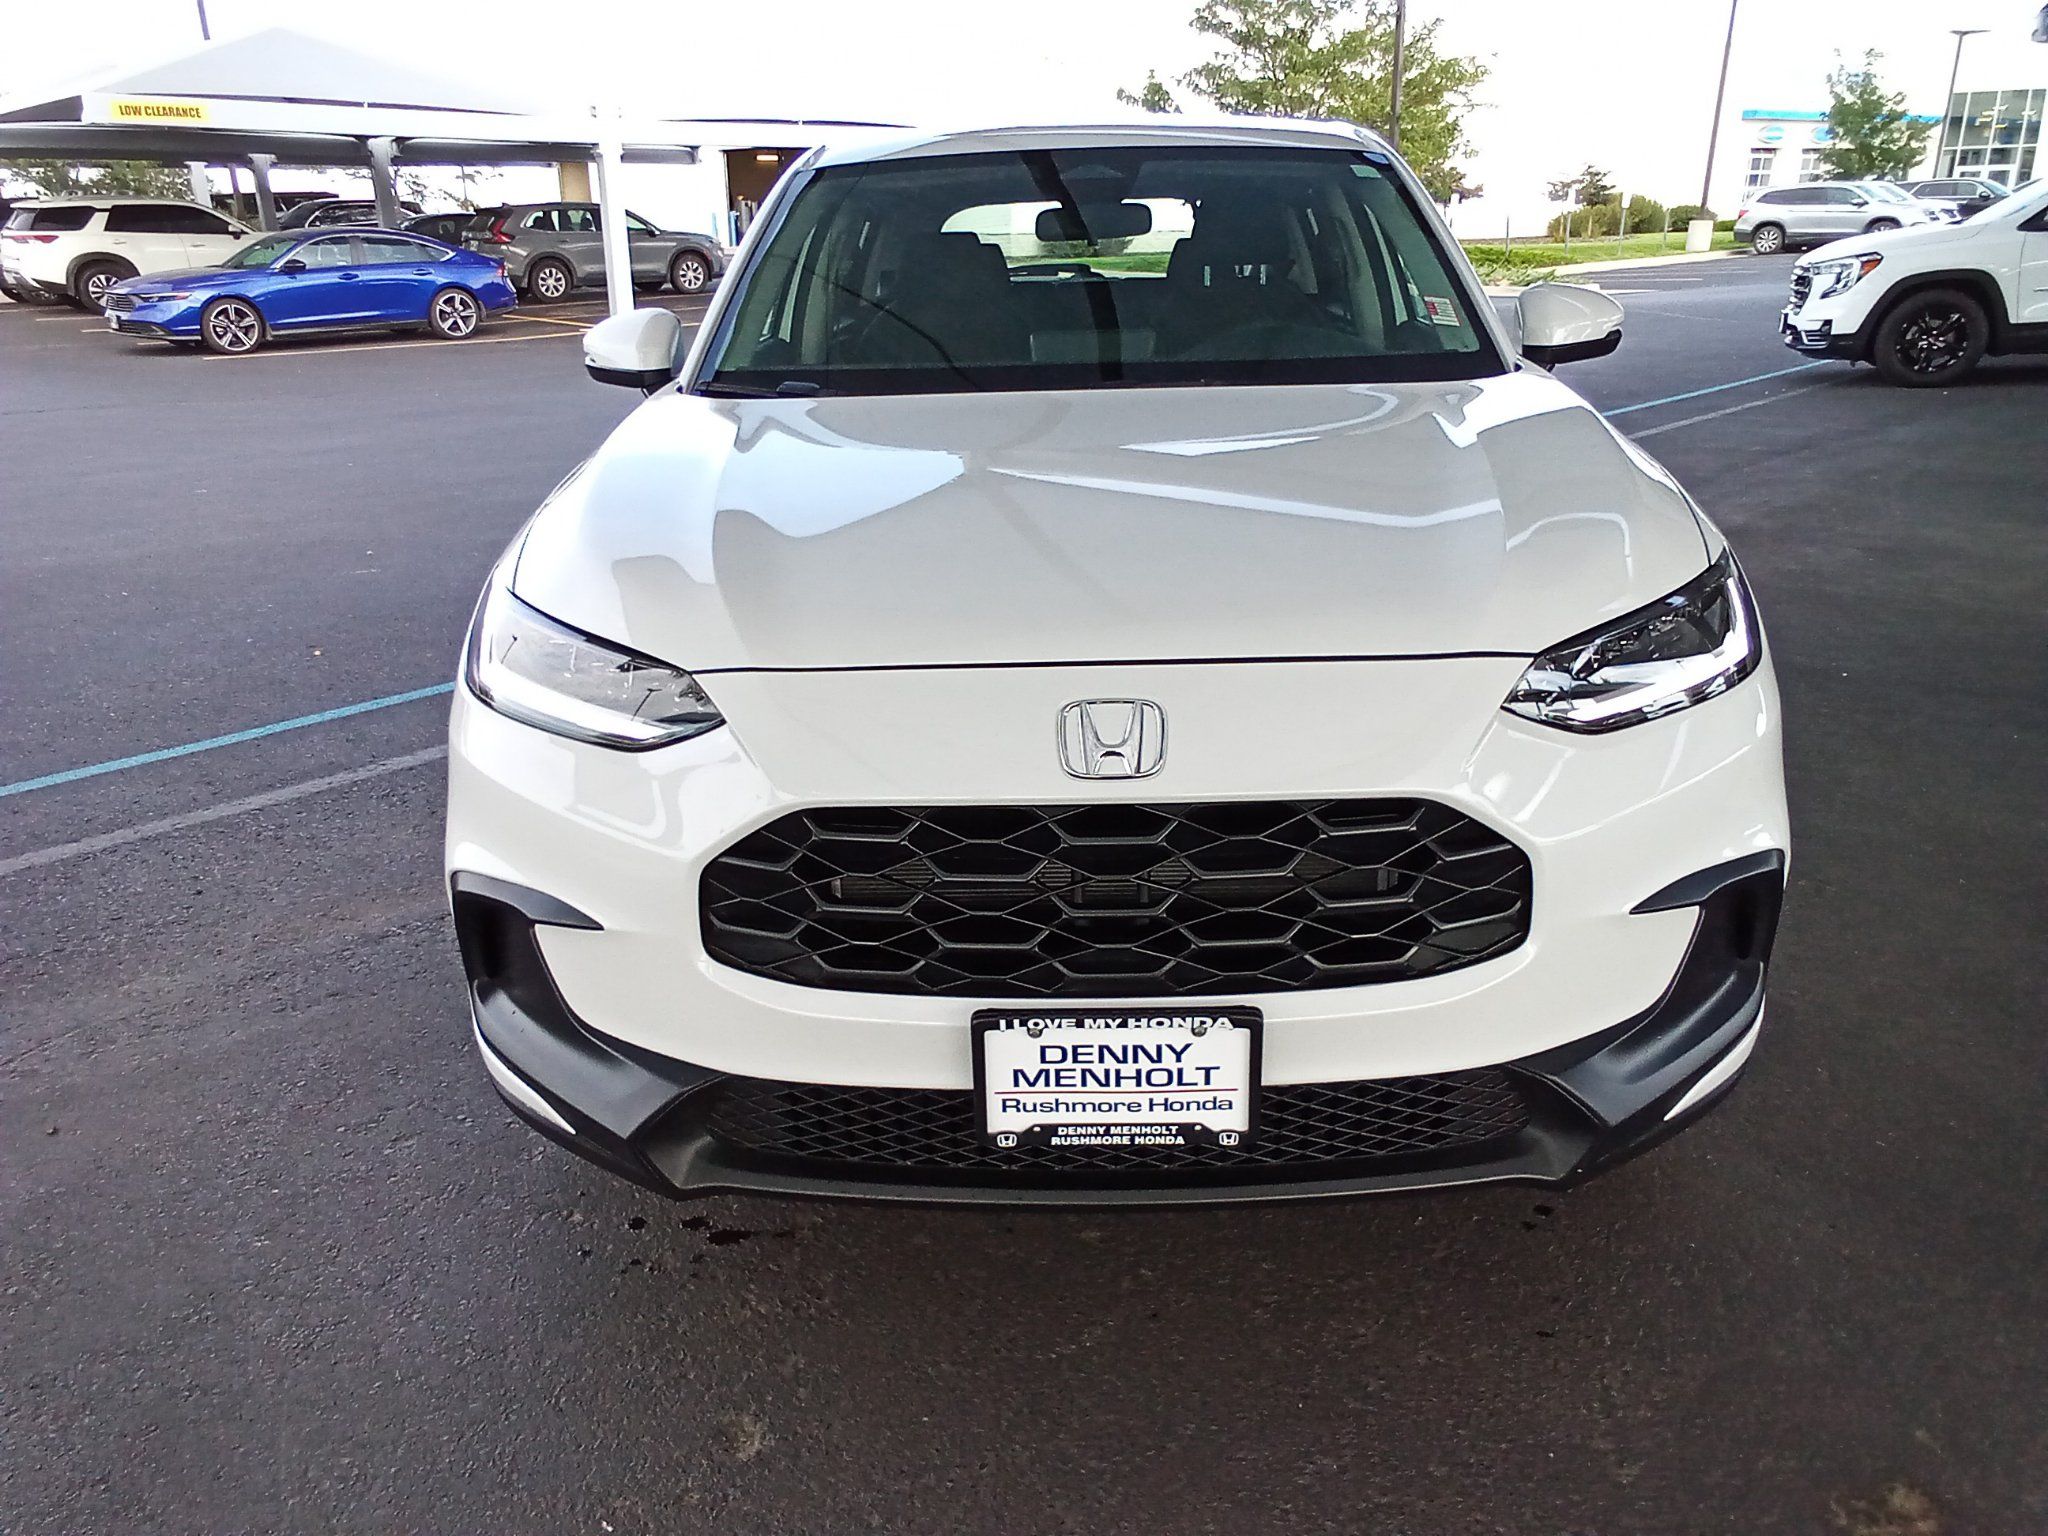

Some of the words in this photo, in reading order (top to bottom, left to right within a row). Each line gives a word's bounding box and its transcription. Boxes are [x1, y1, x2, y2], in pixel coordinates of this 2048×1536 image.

[119, 105, 142, 116] LOW
[144, 106, 202, 118] CLEARANCE
[1084, 1018, 1123, 1030] MY
[1040, 1043, 1193, 1064] DENNY
[1012, 1066, 1221, 1088] MENHOLT
[1001, 1098, 1142, 1113] Rushmore
[1149, 1096, 1233, 1112] Honda
[1057, 1126, 1106, 1136] DENNY
[1110, 1125, 1177, 1135] MENHOLT
[1051, 1135, 1131, 1146] RUSHMORE
[1134, 1134, 1185, 1145] HONDA
